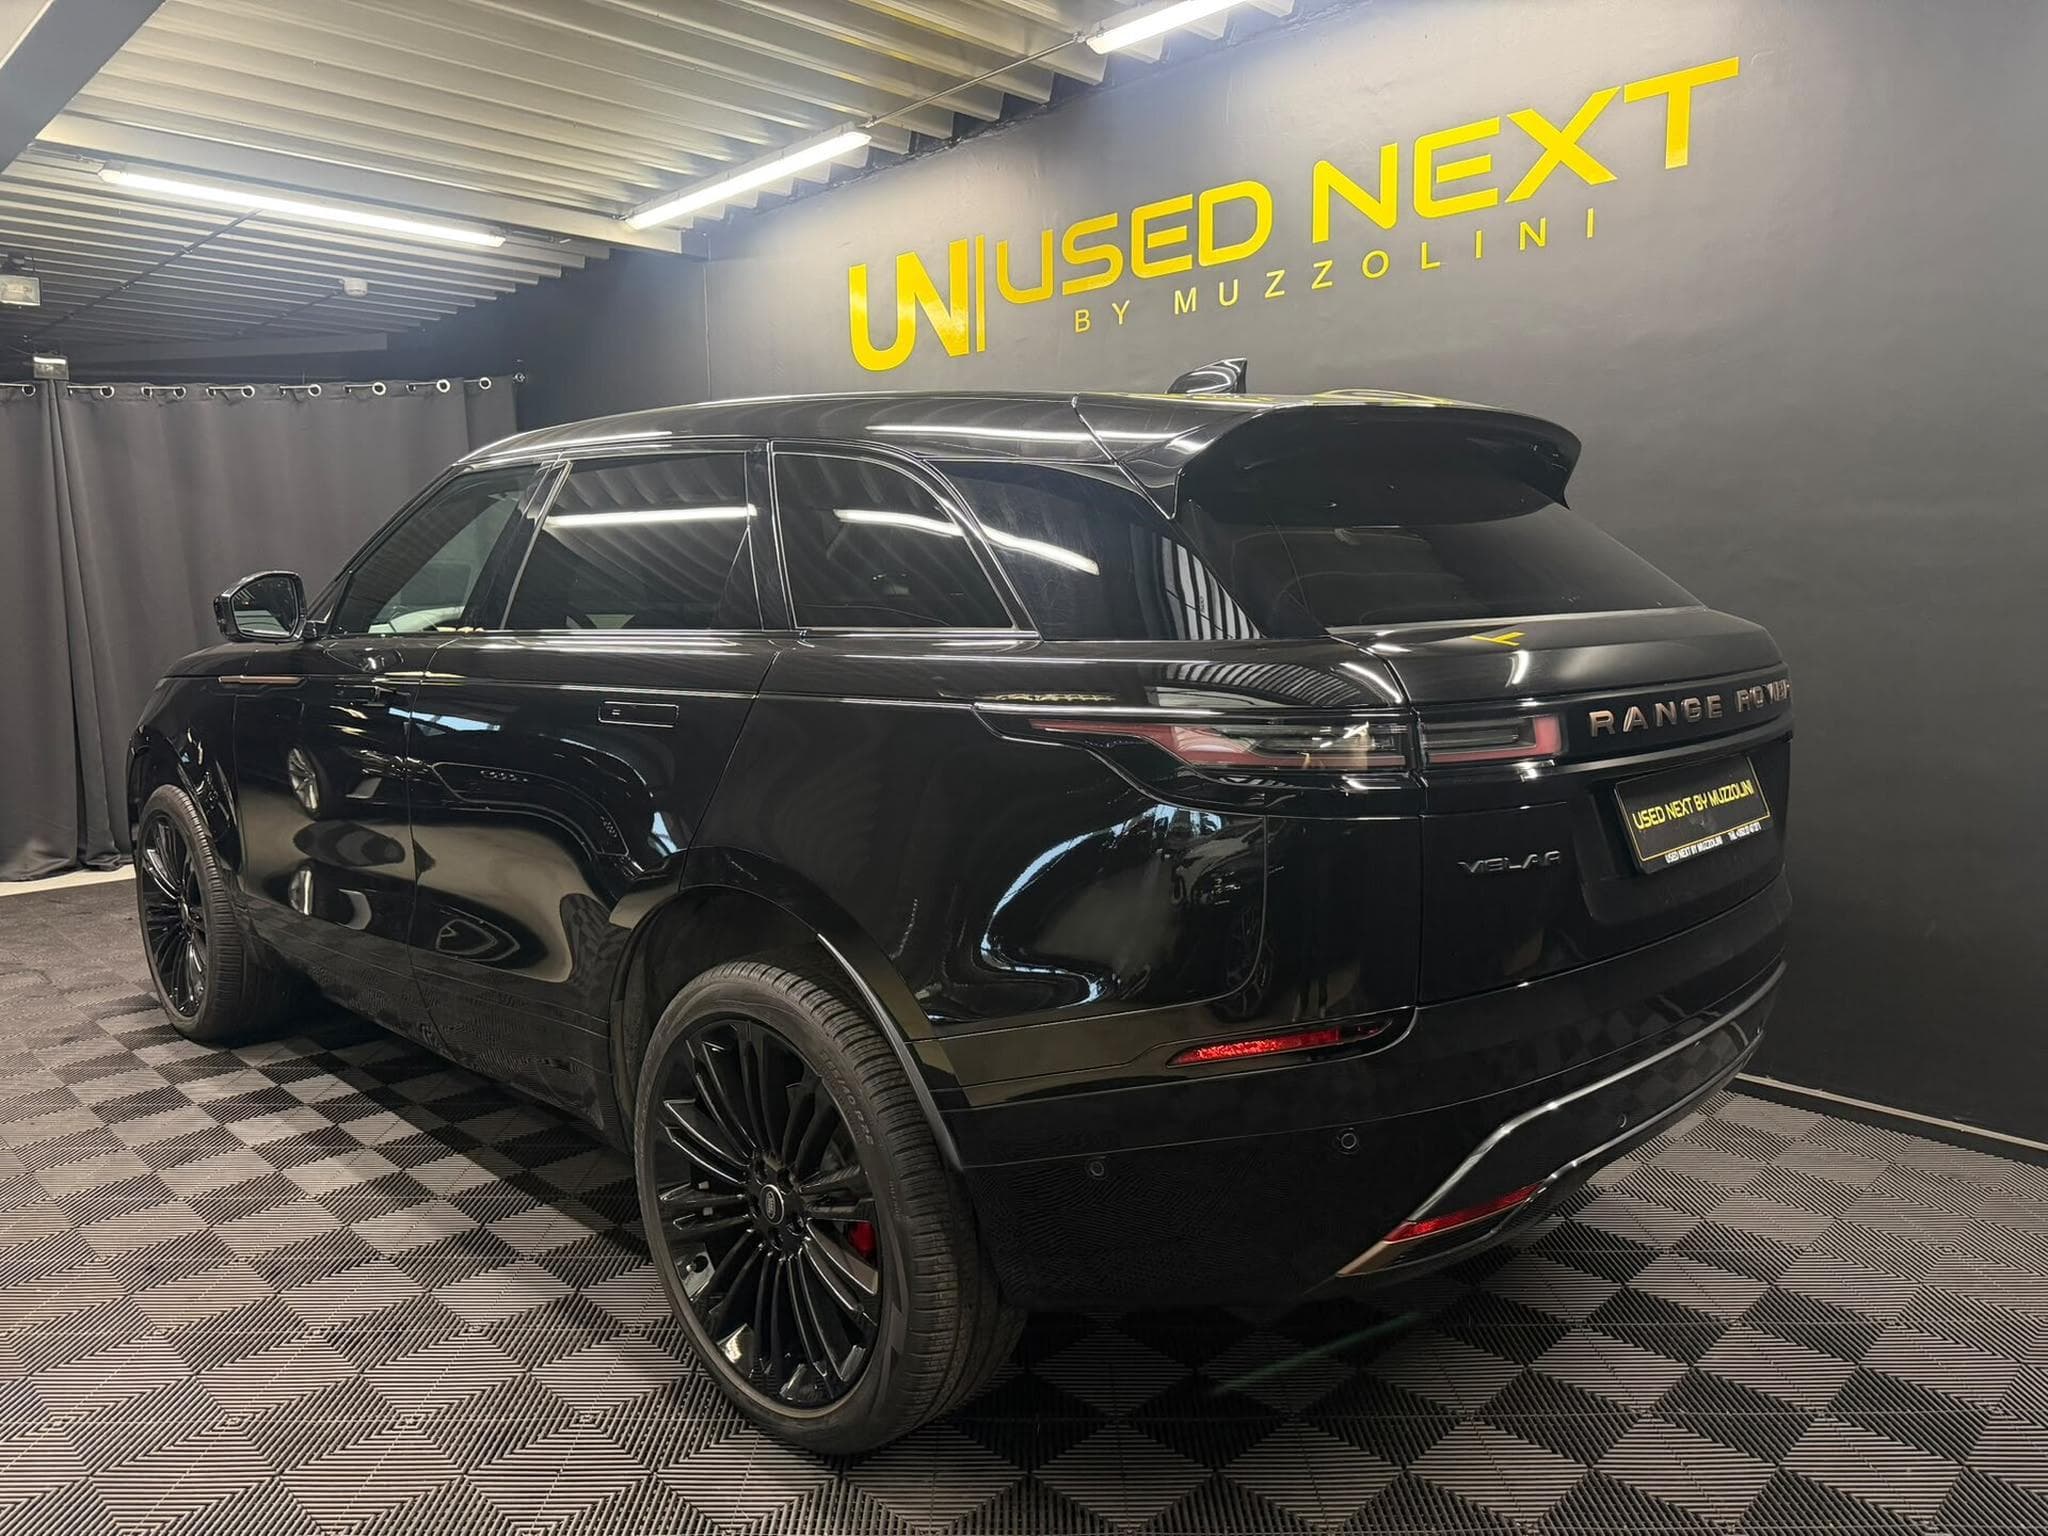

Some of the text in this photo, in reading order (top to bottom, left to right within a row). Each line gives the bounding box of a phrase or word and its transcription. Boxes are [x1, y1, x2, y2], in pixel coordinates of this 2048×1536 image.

[994, 55, 1742, 308] USED NEXT
[1073, 207, 1598, 335] BY MUZZOLINI
[1588, 693, 1724, 738] RANGE
[1632, 806, 1665, 829] USED
[1665, 797, 1693, 820] NEXT
[1693, 793, 1708, 812] BY
